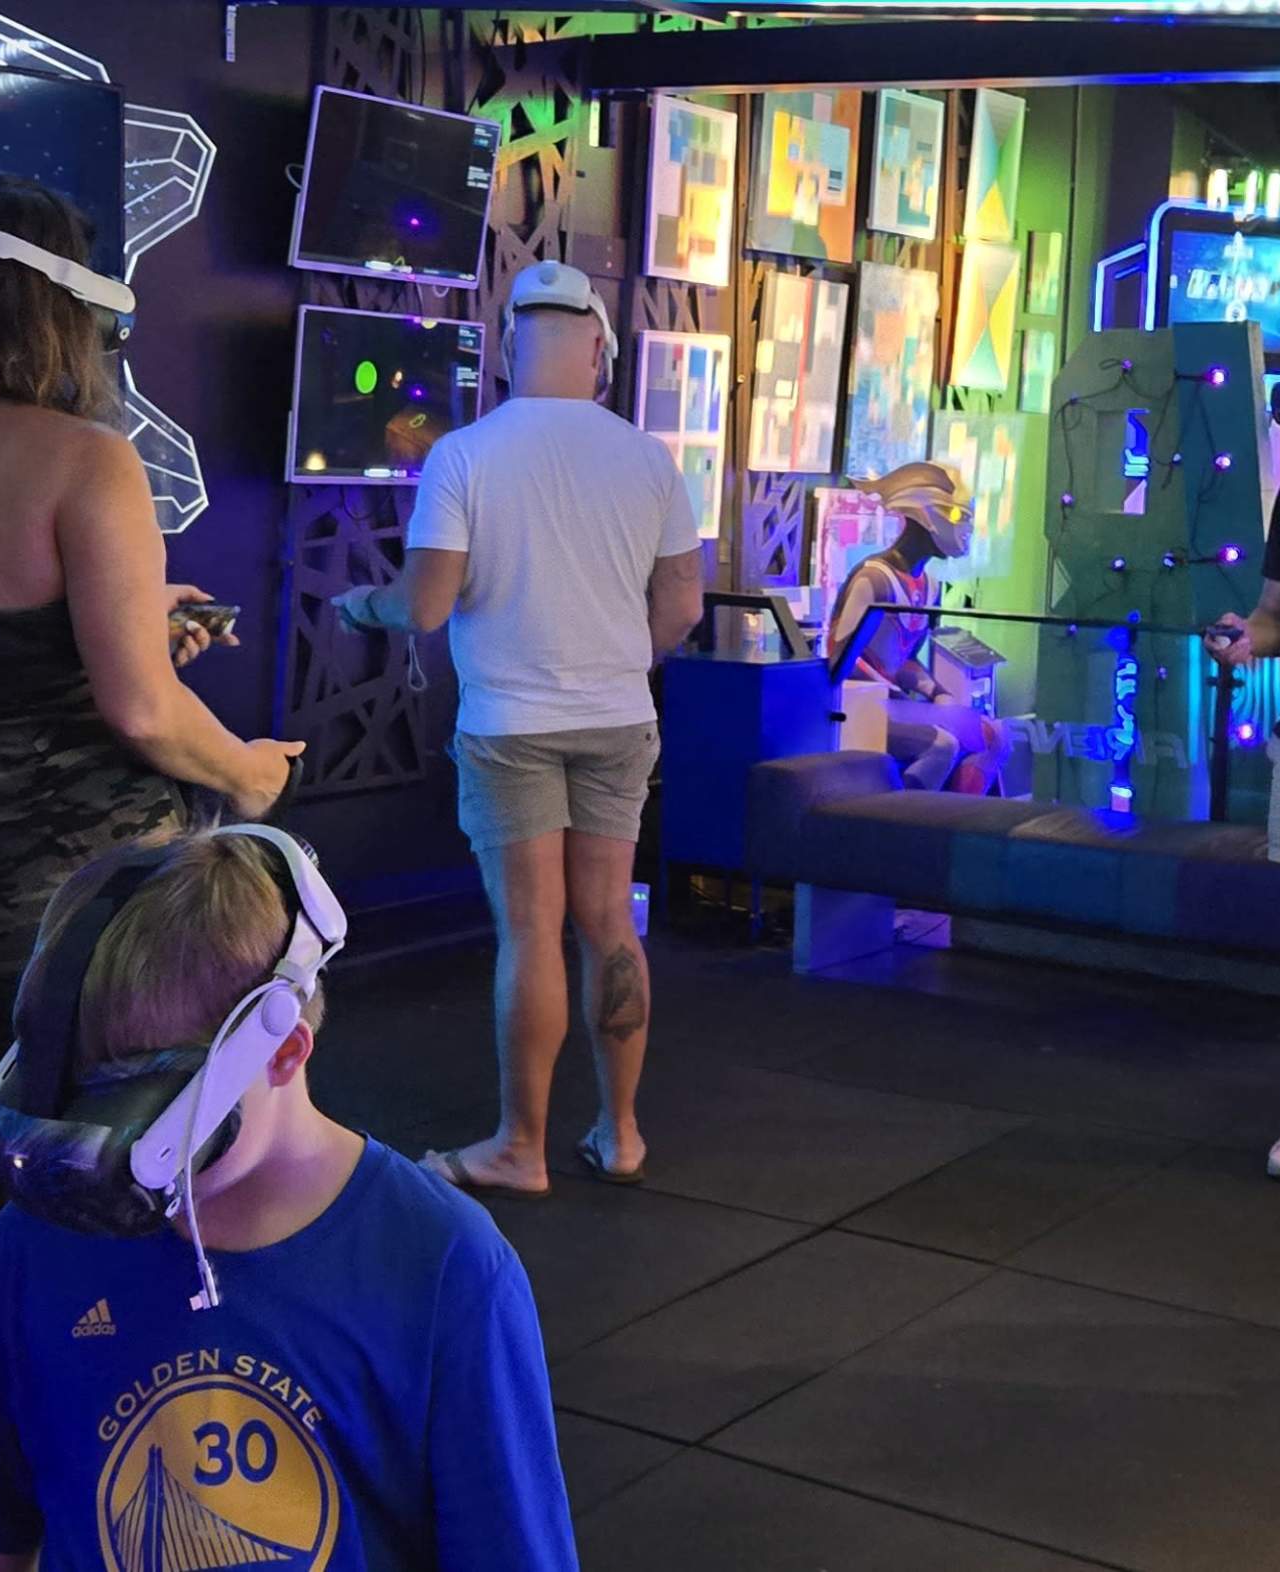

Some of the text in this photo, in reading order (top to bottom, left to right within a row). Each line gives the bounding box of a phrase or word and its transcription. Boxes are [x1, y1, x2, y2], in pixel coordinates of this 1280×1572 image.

[71, 1321, 117, 1338] adidas
[98, 1348, 323, 1441] GOLDEN STATE
[192, 1418, 278, 1487] 30
